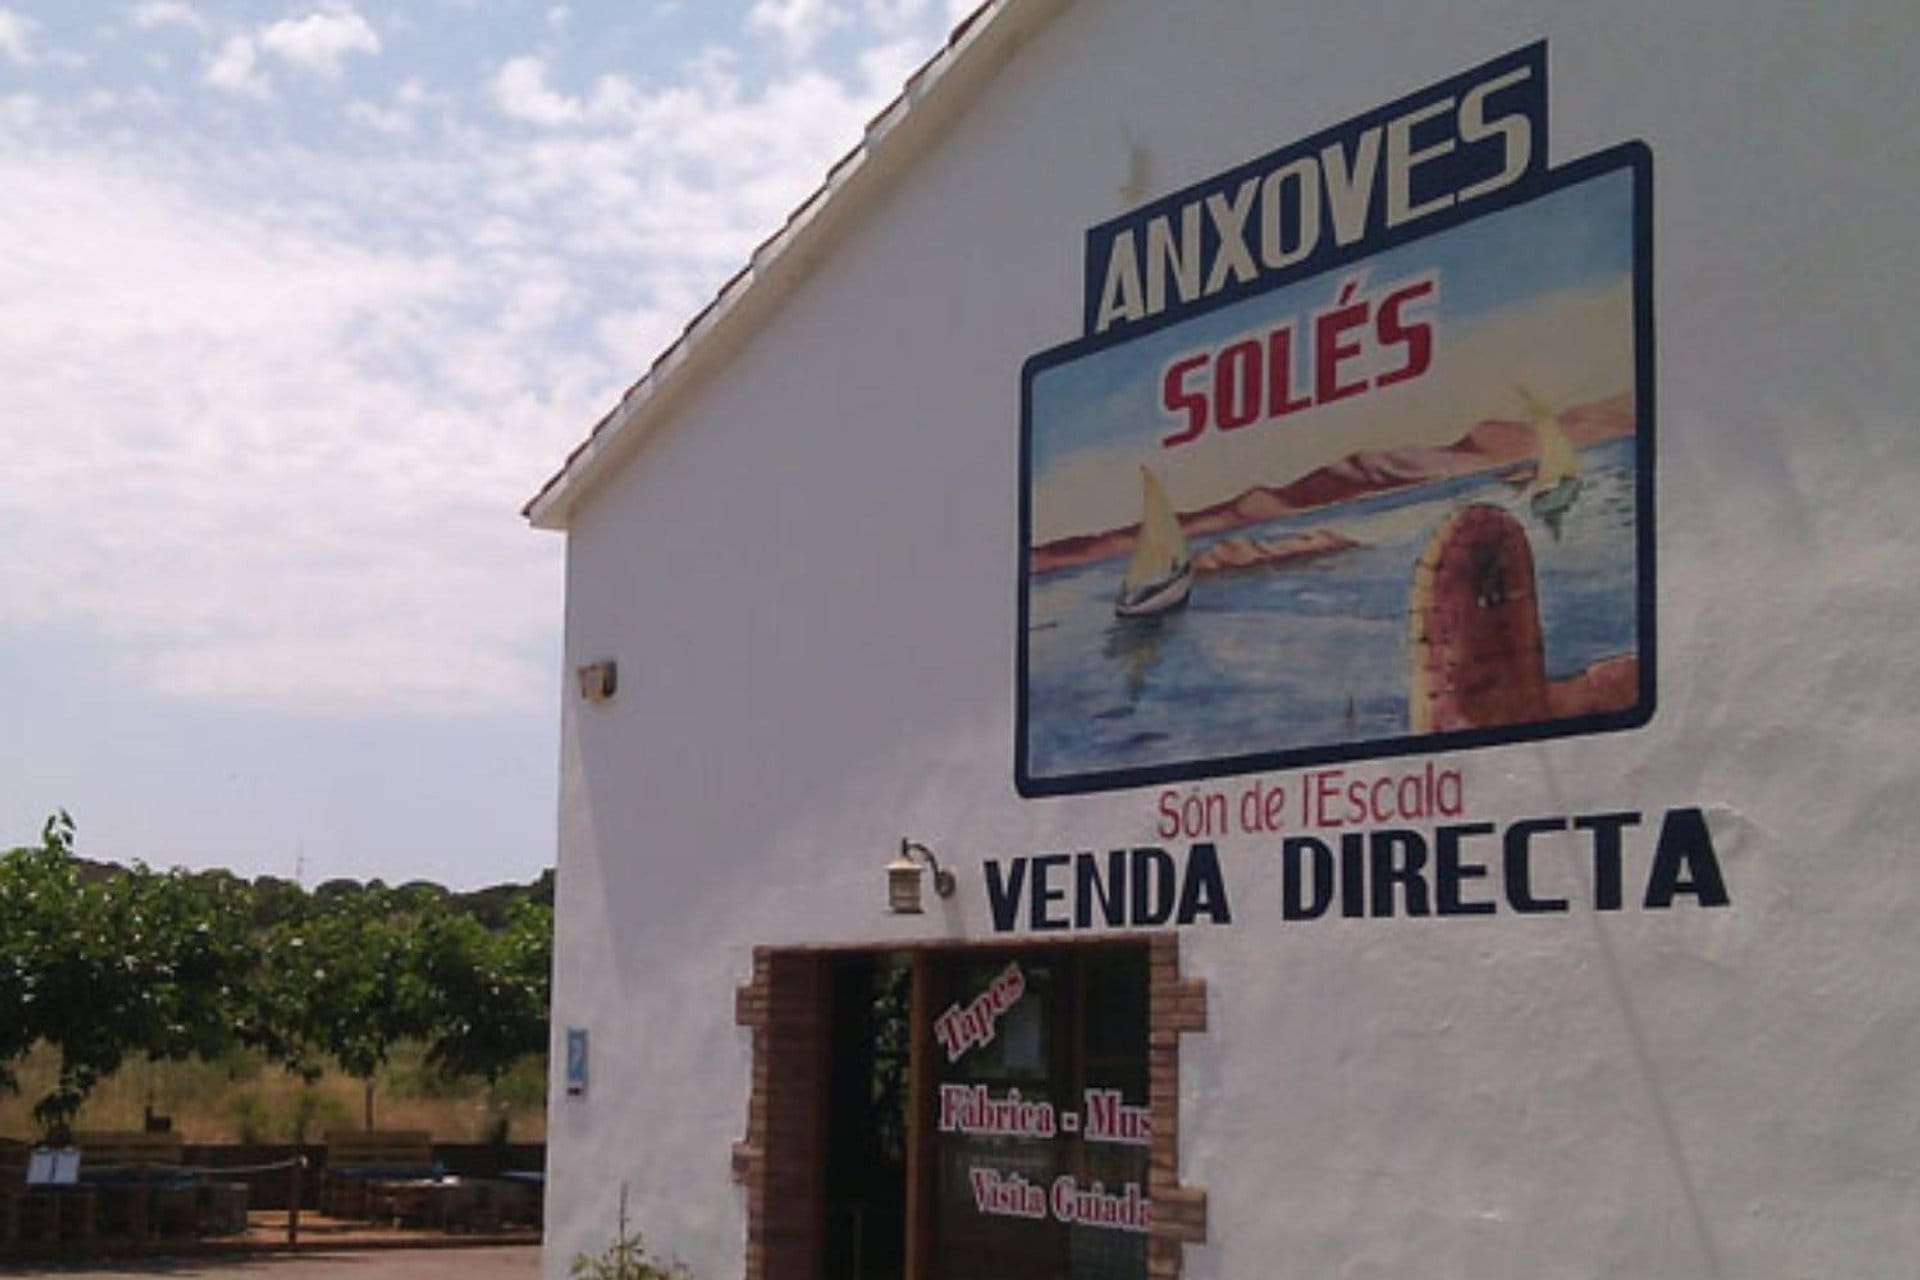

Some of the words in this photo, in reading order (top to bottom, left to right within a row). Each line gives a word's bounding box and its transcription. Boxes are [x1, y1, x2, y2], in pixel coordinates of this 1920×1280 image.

[1095, 65, 1532, 333] ANXOVES
[1161, 279, 1434, 449] SOLÉS
[1241, 779, 1285, 833] de
[984, 843, 1232, 932] VENDA
[1282, 808, 1730, 922] DIRECTA
[933, 960, 1026, 1064] Tapes
[970, 1166, 1047, 1218] Visita
